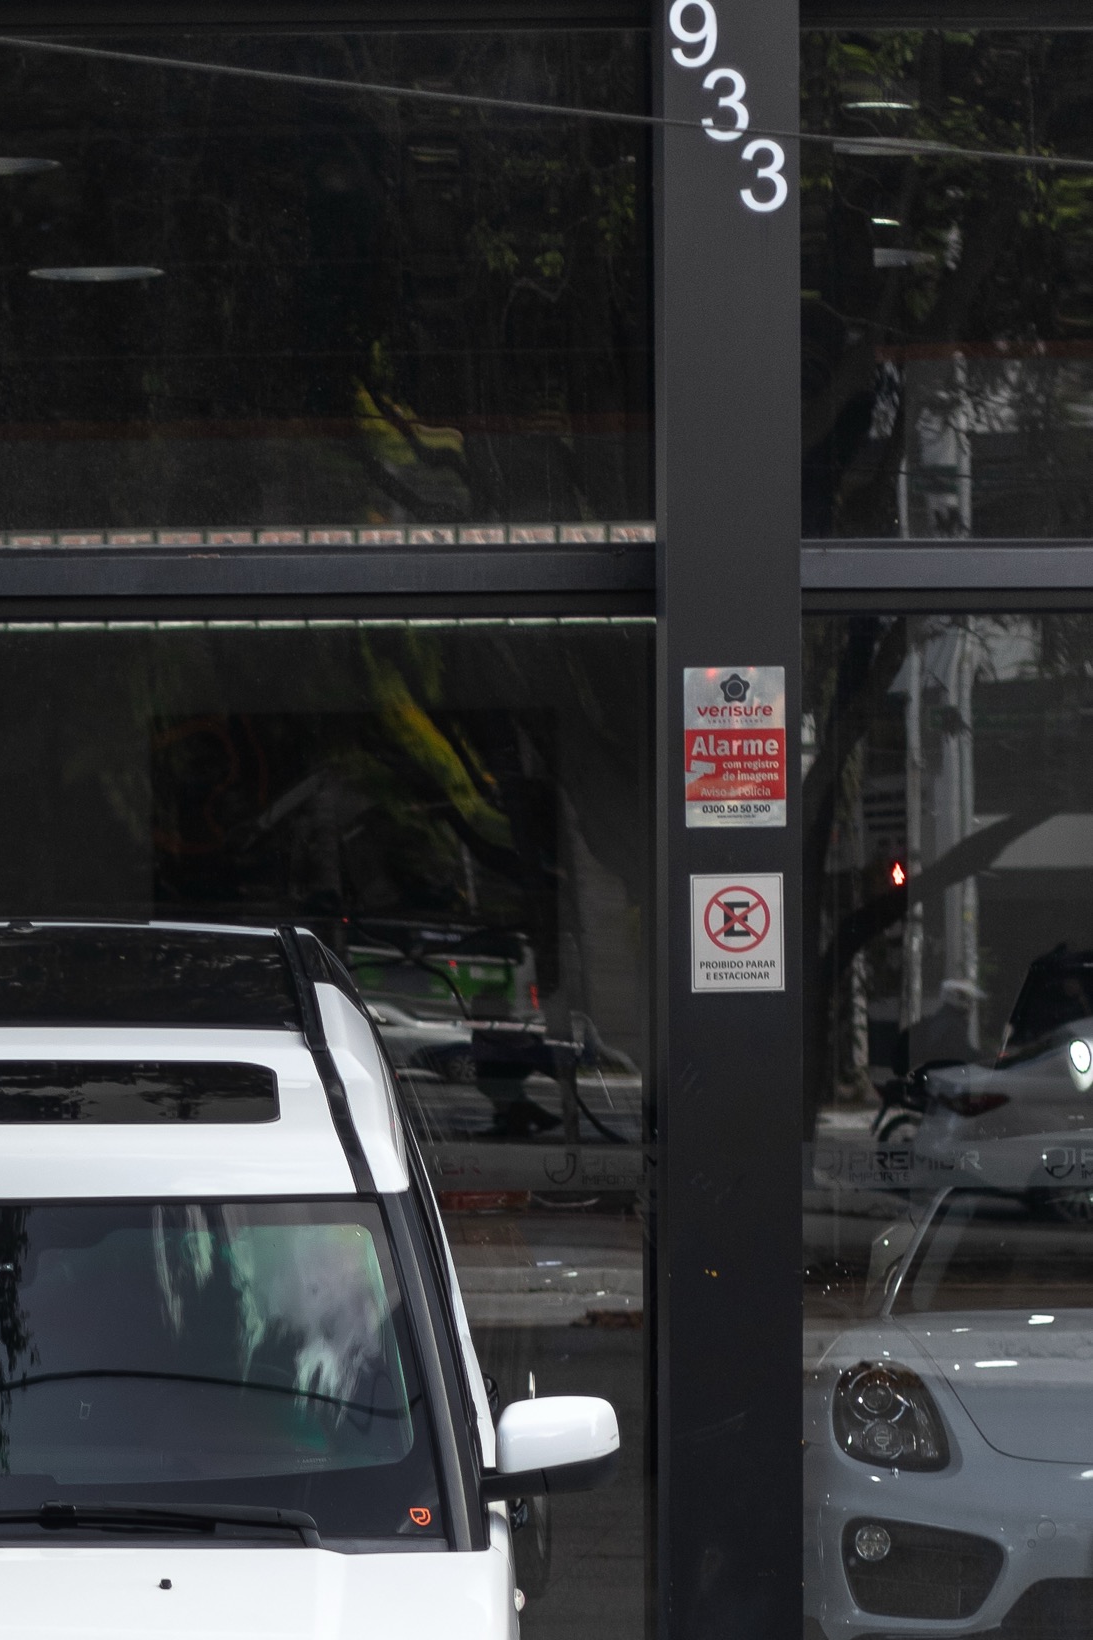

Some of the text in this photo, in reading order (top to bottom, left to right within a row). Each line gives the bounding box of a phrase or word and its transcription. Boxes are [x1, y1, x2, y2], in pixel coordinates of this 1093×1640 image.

[670, 0, 787, 212] 933
[697, 704, 773, 717] verisure
[691, 734, 779, 757] Alarme
[722, 758, 779, 772] com registro
[722, 770, 779, 783] de imagens
[700, 787, 727, 797] Aviso
[702, 803, 771, 814] 0300 50 50 500
[700, 960, 776, 970] PROIBIDO PARAR
[706, 971, 770, 981] E ESTACIONAR
